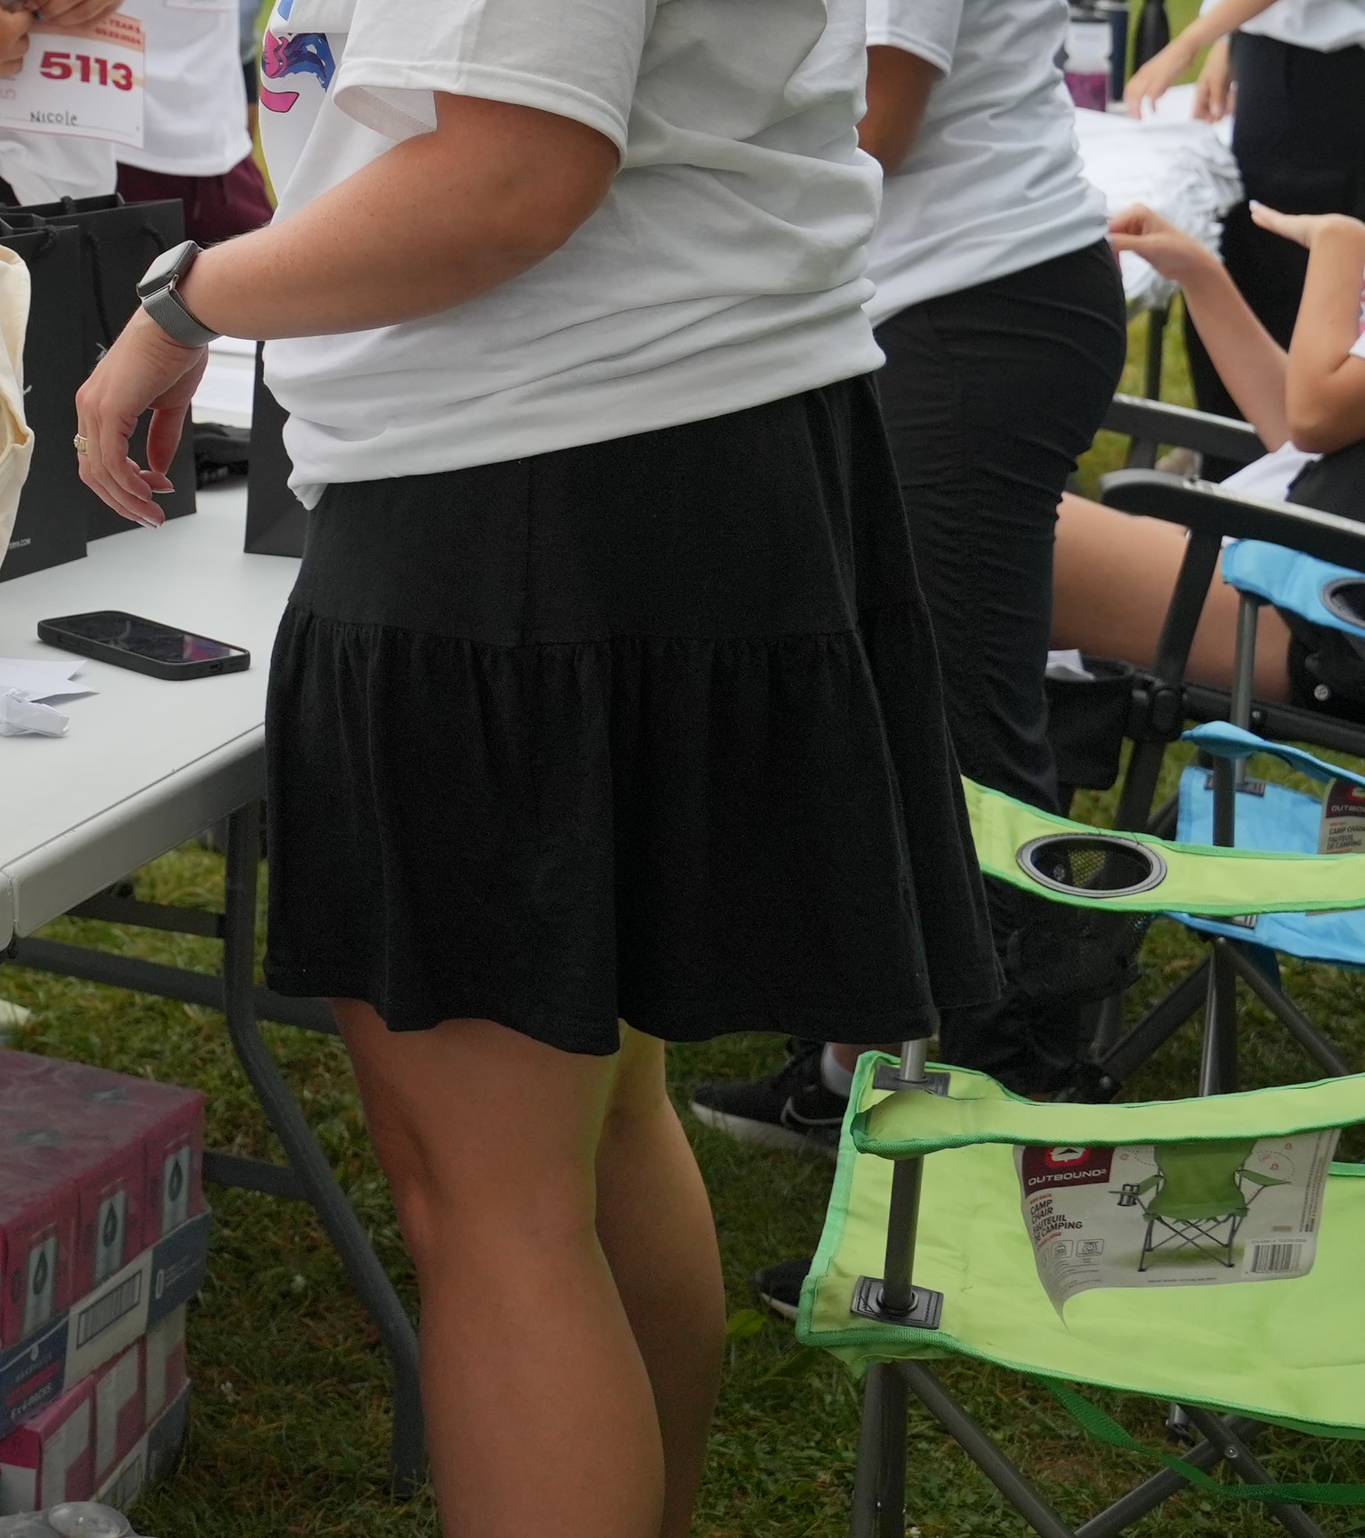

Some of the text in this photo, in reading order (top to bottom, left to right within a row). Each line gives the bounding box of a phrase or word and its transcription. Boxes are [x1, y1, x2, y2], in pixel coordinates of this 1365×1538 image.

[40, 51, 133, 92] 5113
[1028, 1168, 1102, 1186] OUTBOUND
[1030, 1199, 1053, 1215] CAMP
[1031, 1207, 1054, 1224] CHAIR
[1041, 1221, 1083, 1237] CAMPING
